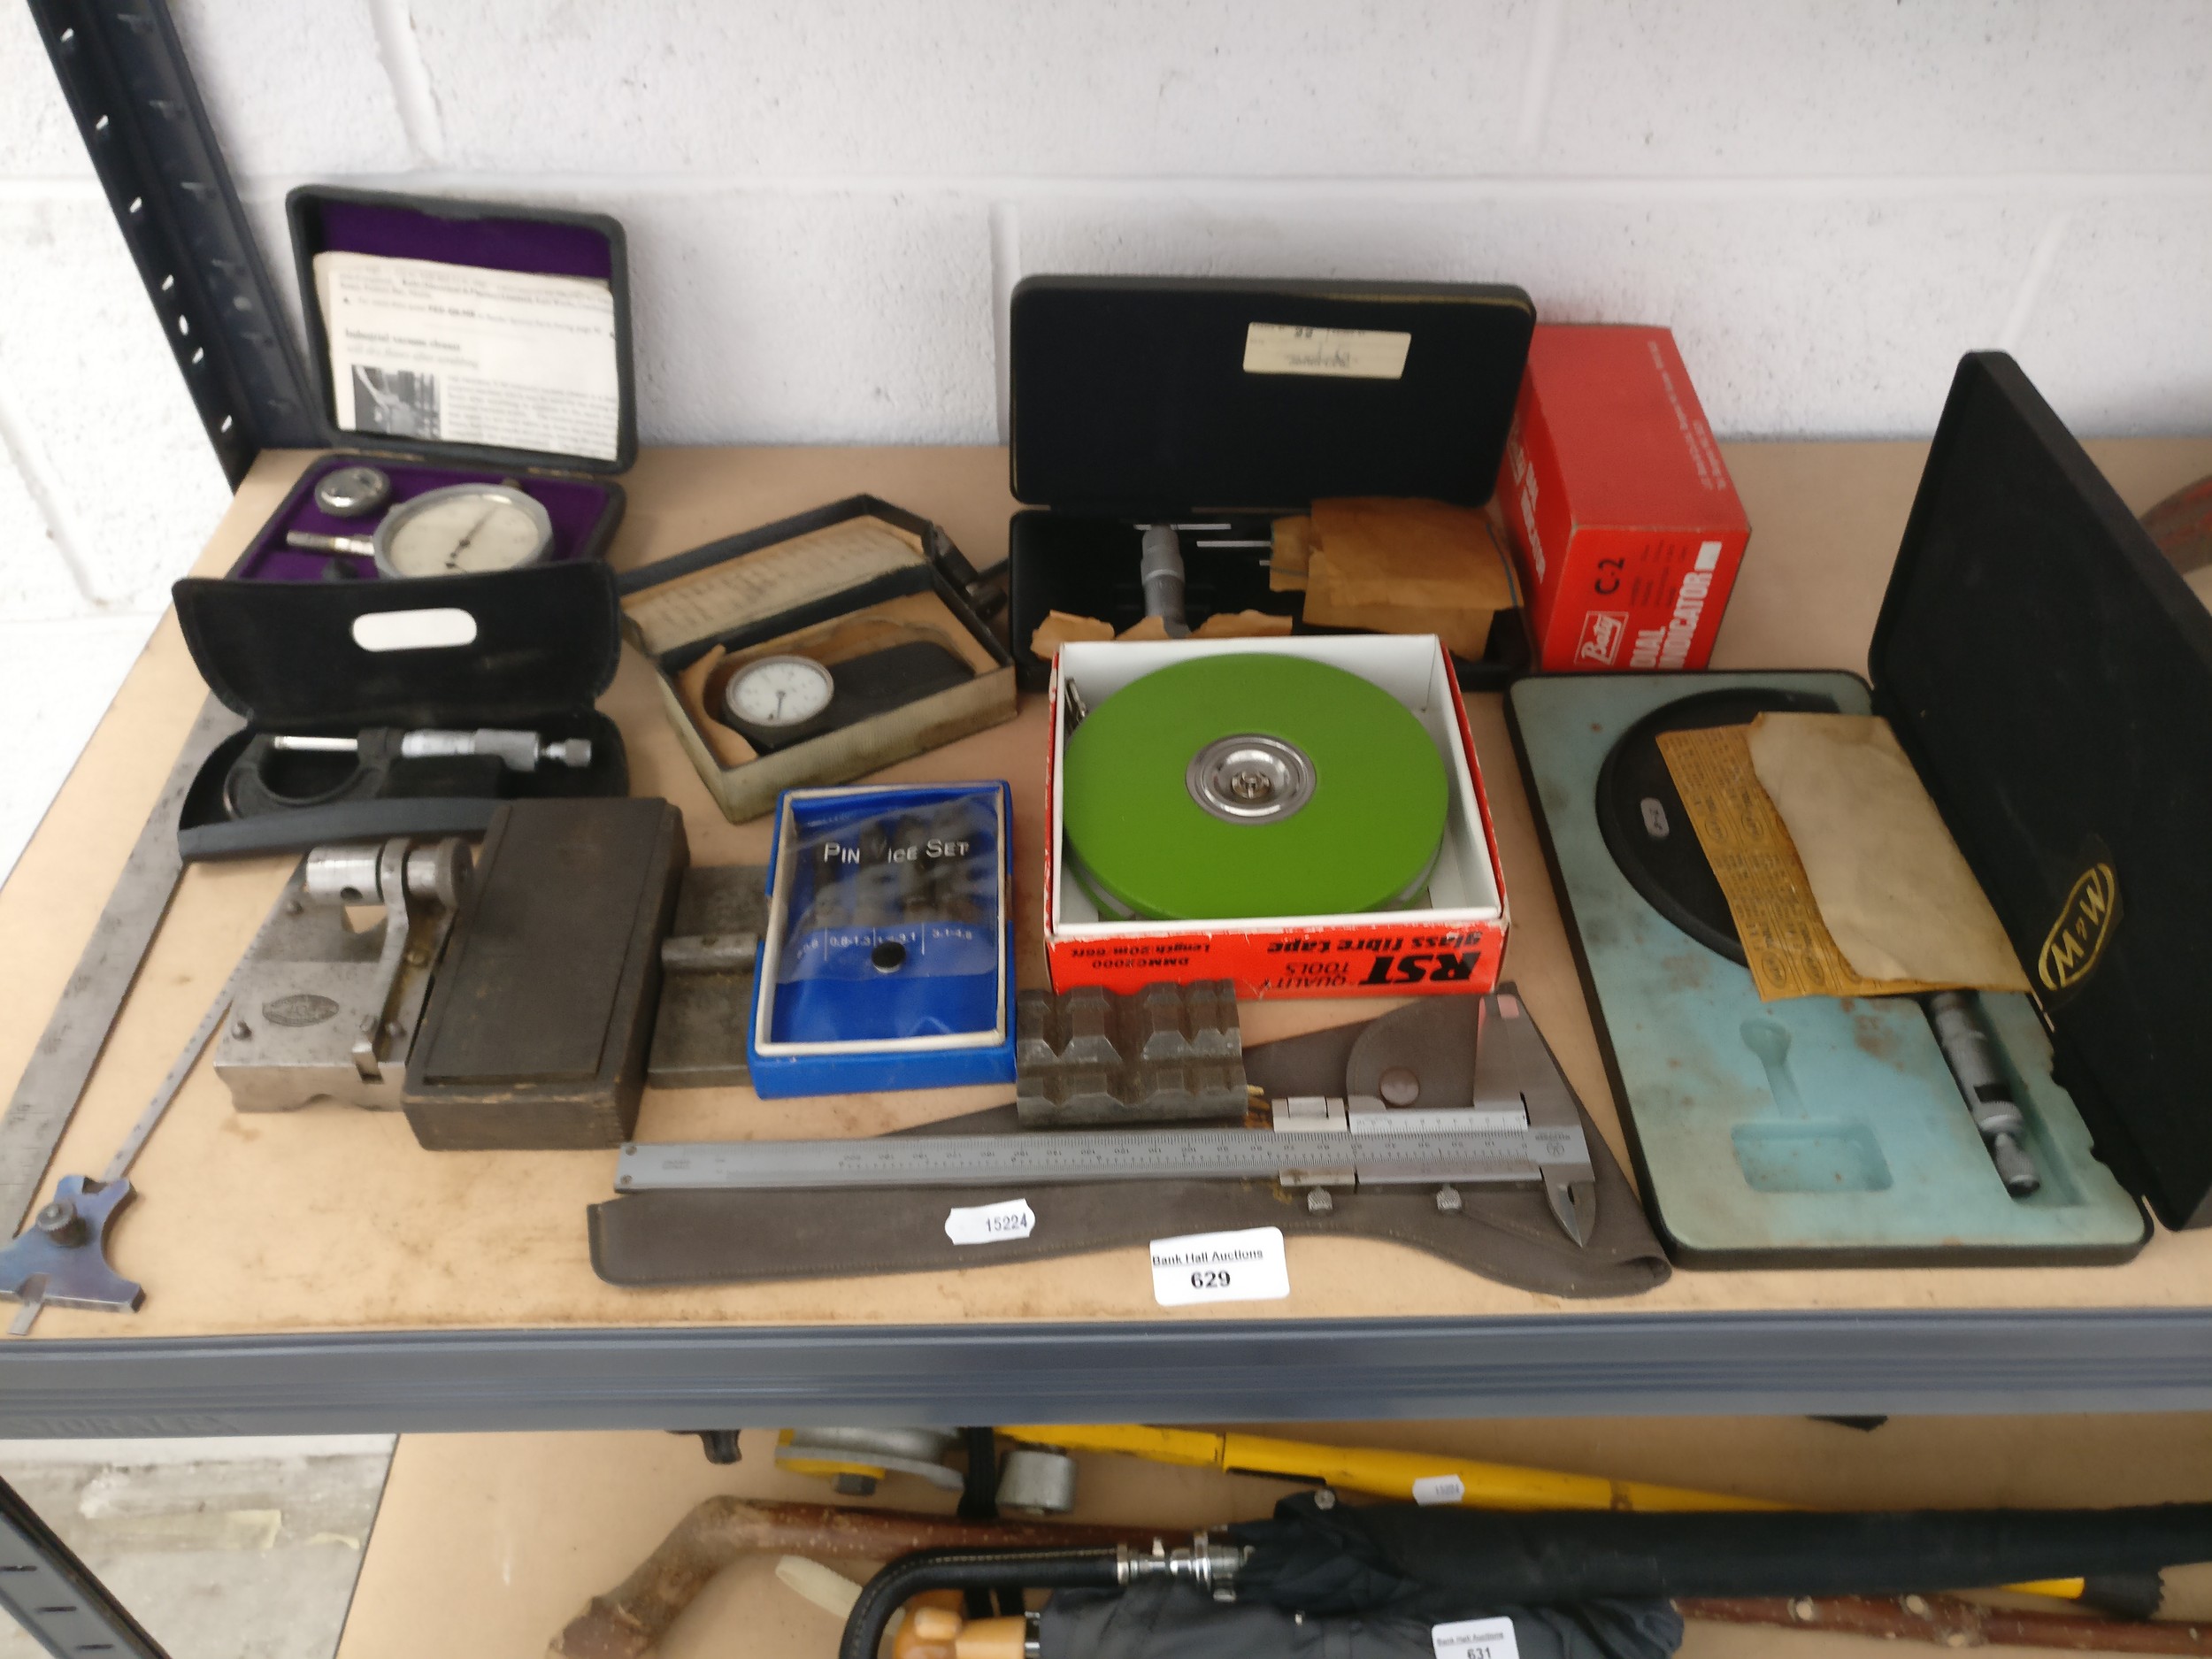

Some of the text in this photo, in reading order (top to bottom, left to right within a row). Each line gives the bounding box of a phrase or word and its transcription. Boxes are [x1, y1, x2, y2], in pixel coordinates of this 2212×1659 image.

[1658, 572, 1713, 669] INDICATOR
[1581, 613, 1622, 664] Baty
[1630, 626, 1666, 668] DIAL
[824, 841, 860, 864] PIN
[926, 839, 970, 858] SET
[1267, 932, 1483, 954] glass fibre tape
[1286, 961, 1349, 975] TOOLS
[1358, 951, 1481, 986] RST
[986, 1212, 1028, 1233] 15224
[1152, 1249, 1263, 1266] Bank Hall Auctions
[1191, 1270, 1231, 1289] 629
[1467, 1646, 1493, 1659] 631
